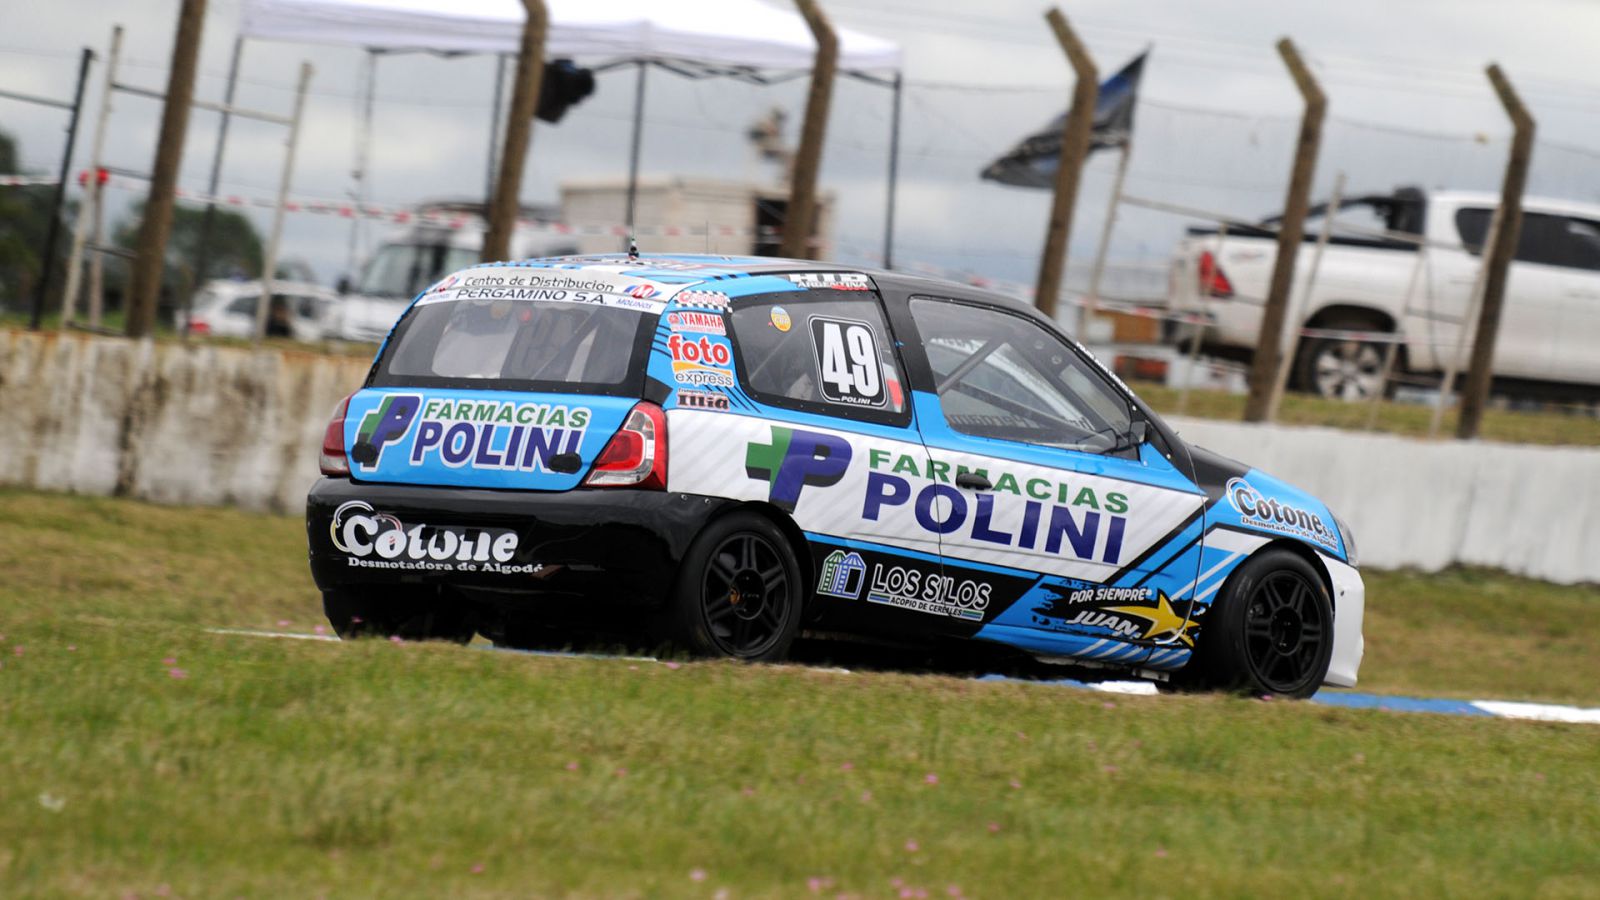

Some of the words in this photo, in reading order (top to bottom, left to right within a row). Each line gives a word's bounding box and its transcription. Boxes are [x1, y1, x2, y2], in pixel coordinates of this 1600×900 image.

[464, 276, 504, 287] Centro
[509, 276, 525, 287] de
[456, 288, 567, 301] PERGAMINO
[571, 291, 608, 305] S.A.
[681, 312, 724, 328] YAMAHA
[668, 335, 728, 364] foto
[822, 322, 880, 397] 49
[675, 372, 732, 386] express
[841, 396, 871, 405] POLINI
[423, 401, 589, 428] FARMACIAS
[412, 421, 582, 471] POLINI
[861, 471, 1127, 564] POLINI
[1235, 488, 1323, 533] Cotone
[341, 513, 519, 563] Cotone
[348, 557, 453, 571] Desmotadora
[457, 562, 476, 572] de
[871, 563, 921, 597] LOS
[922, 573, 992, 610] SILOS
[1069, 588, 1094, 605] POR
[889, 596, 917, 608] ACOPIO
[918, 602, 927, 610] DE
